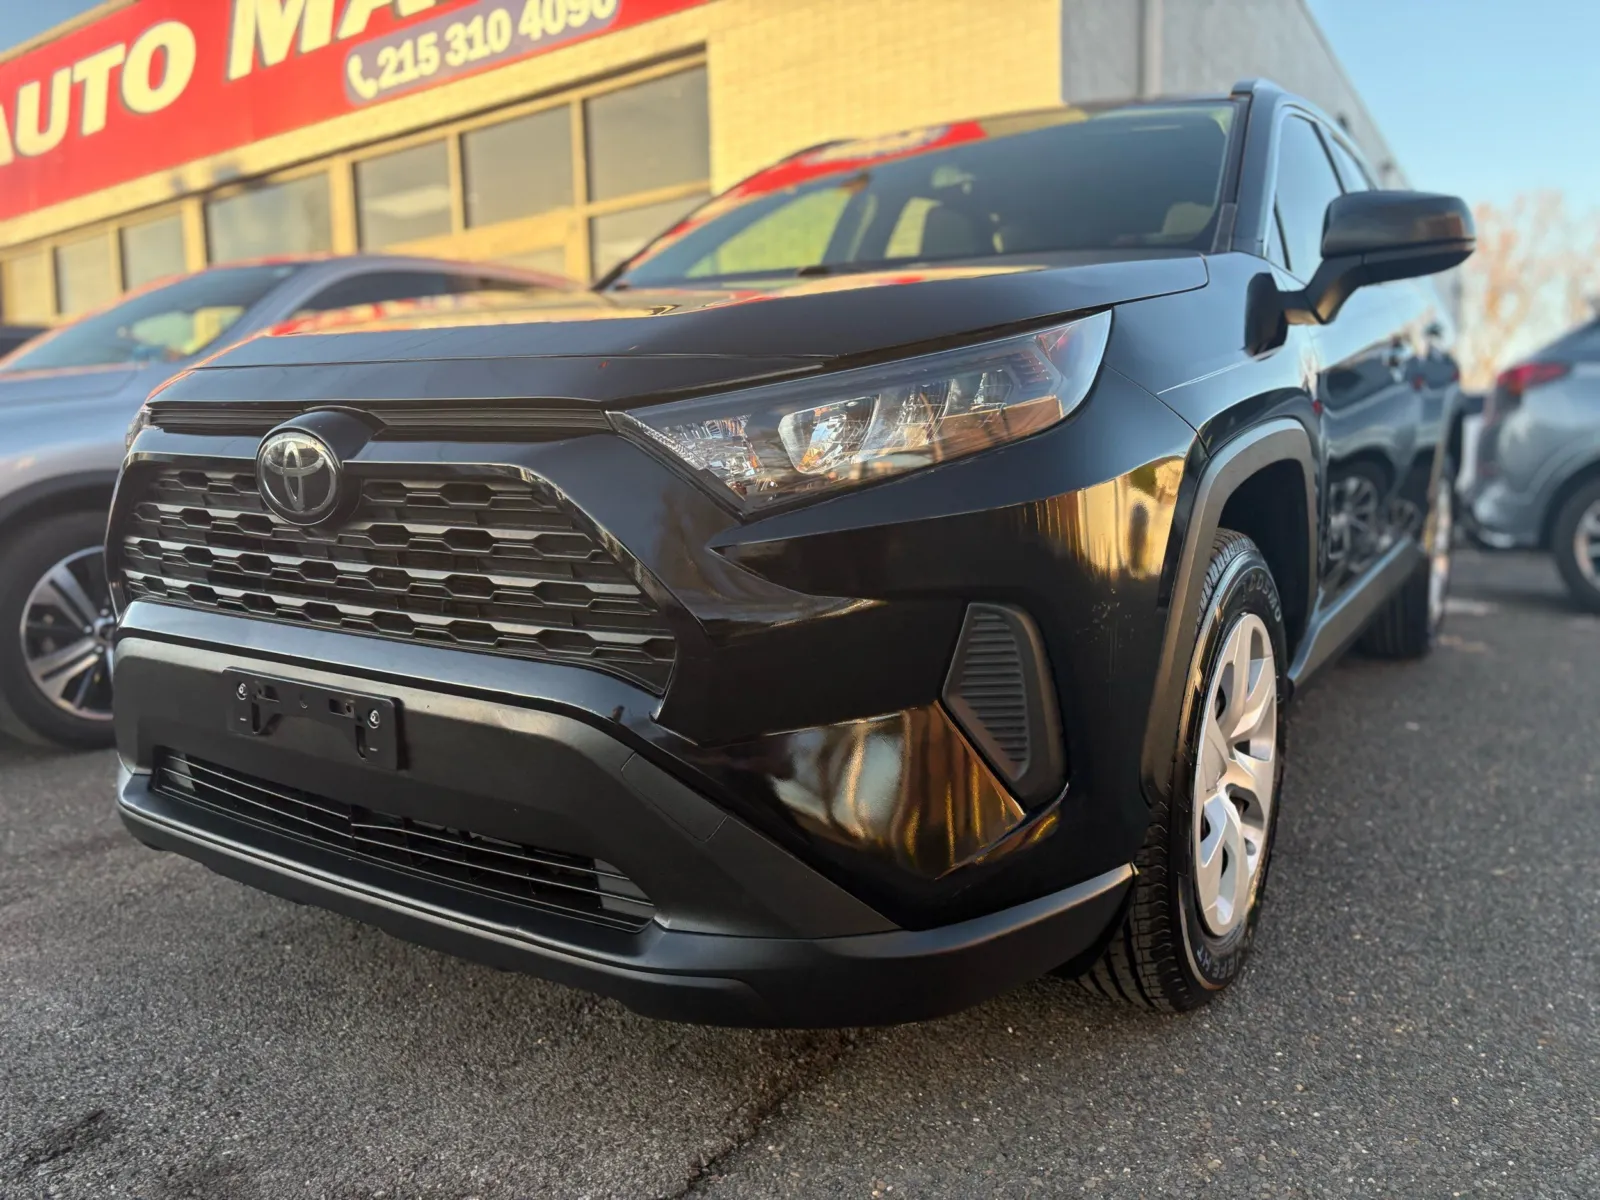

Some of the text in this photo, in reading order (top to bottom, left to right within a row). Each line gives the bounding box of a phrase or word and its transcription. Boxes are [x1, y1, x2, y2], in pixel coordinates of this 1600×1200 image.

[228, 0, 437, 81] M
[377, 31, 440, 89] 215
[445, 8, 512, 66] 310
[1248, 573, 1281, 622] COSMO
